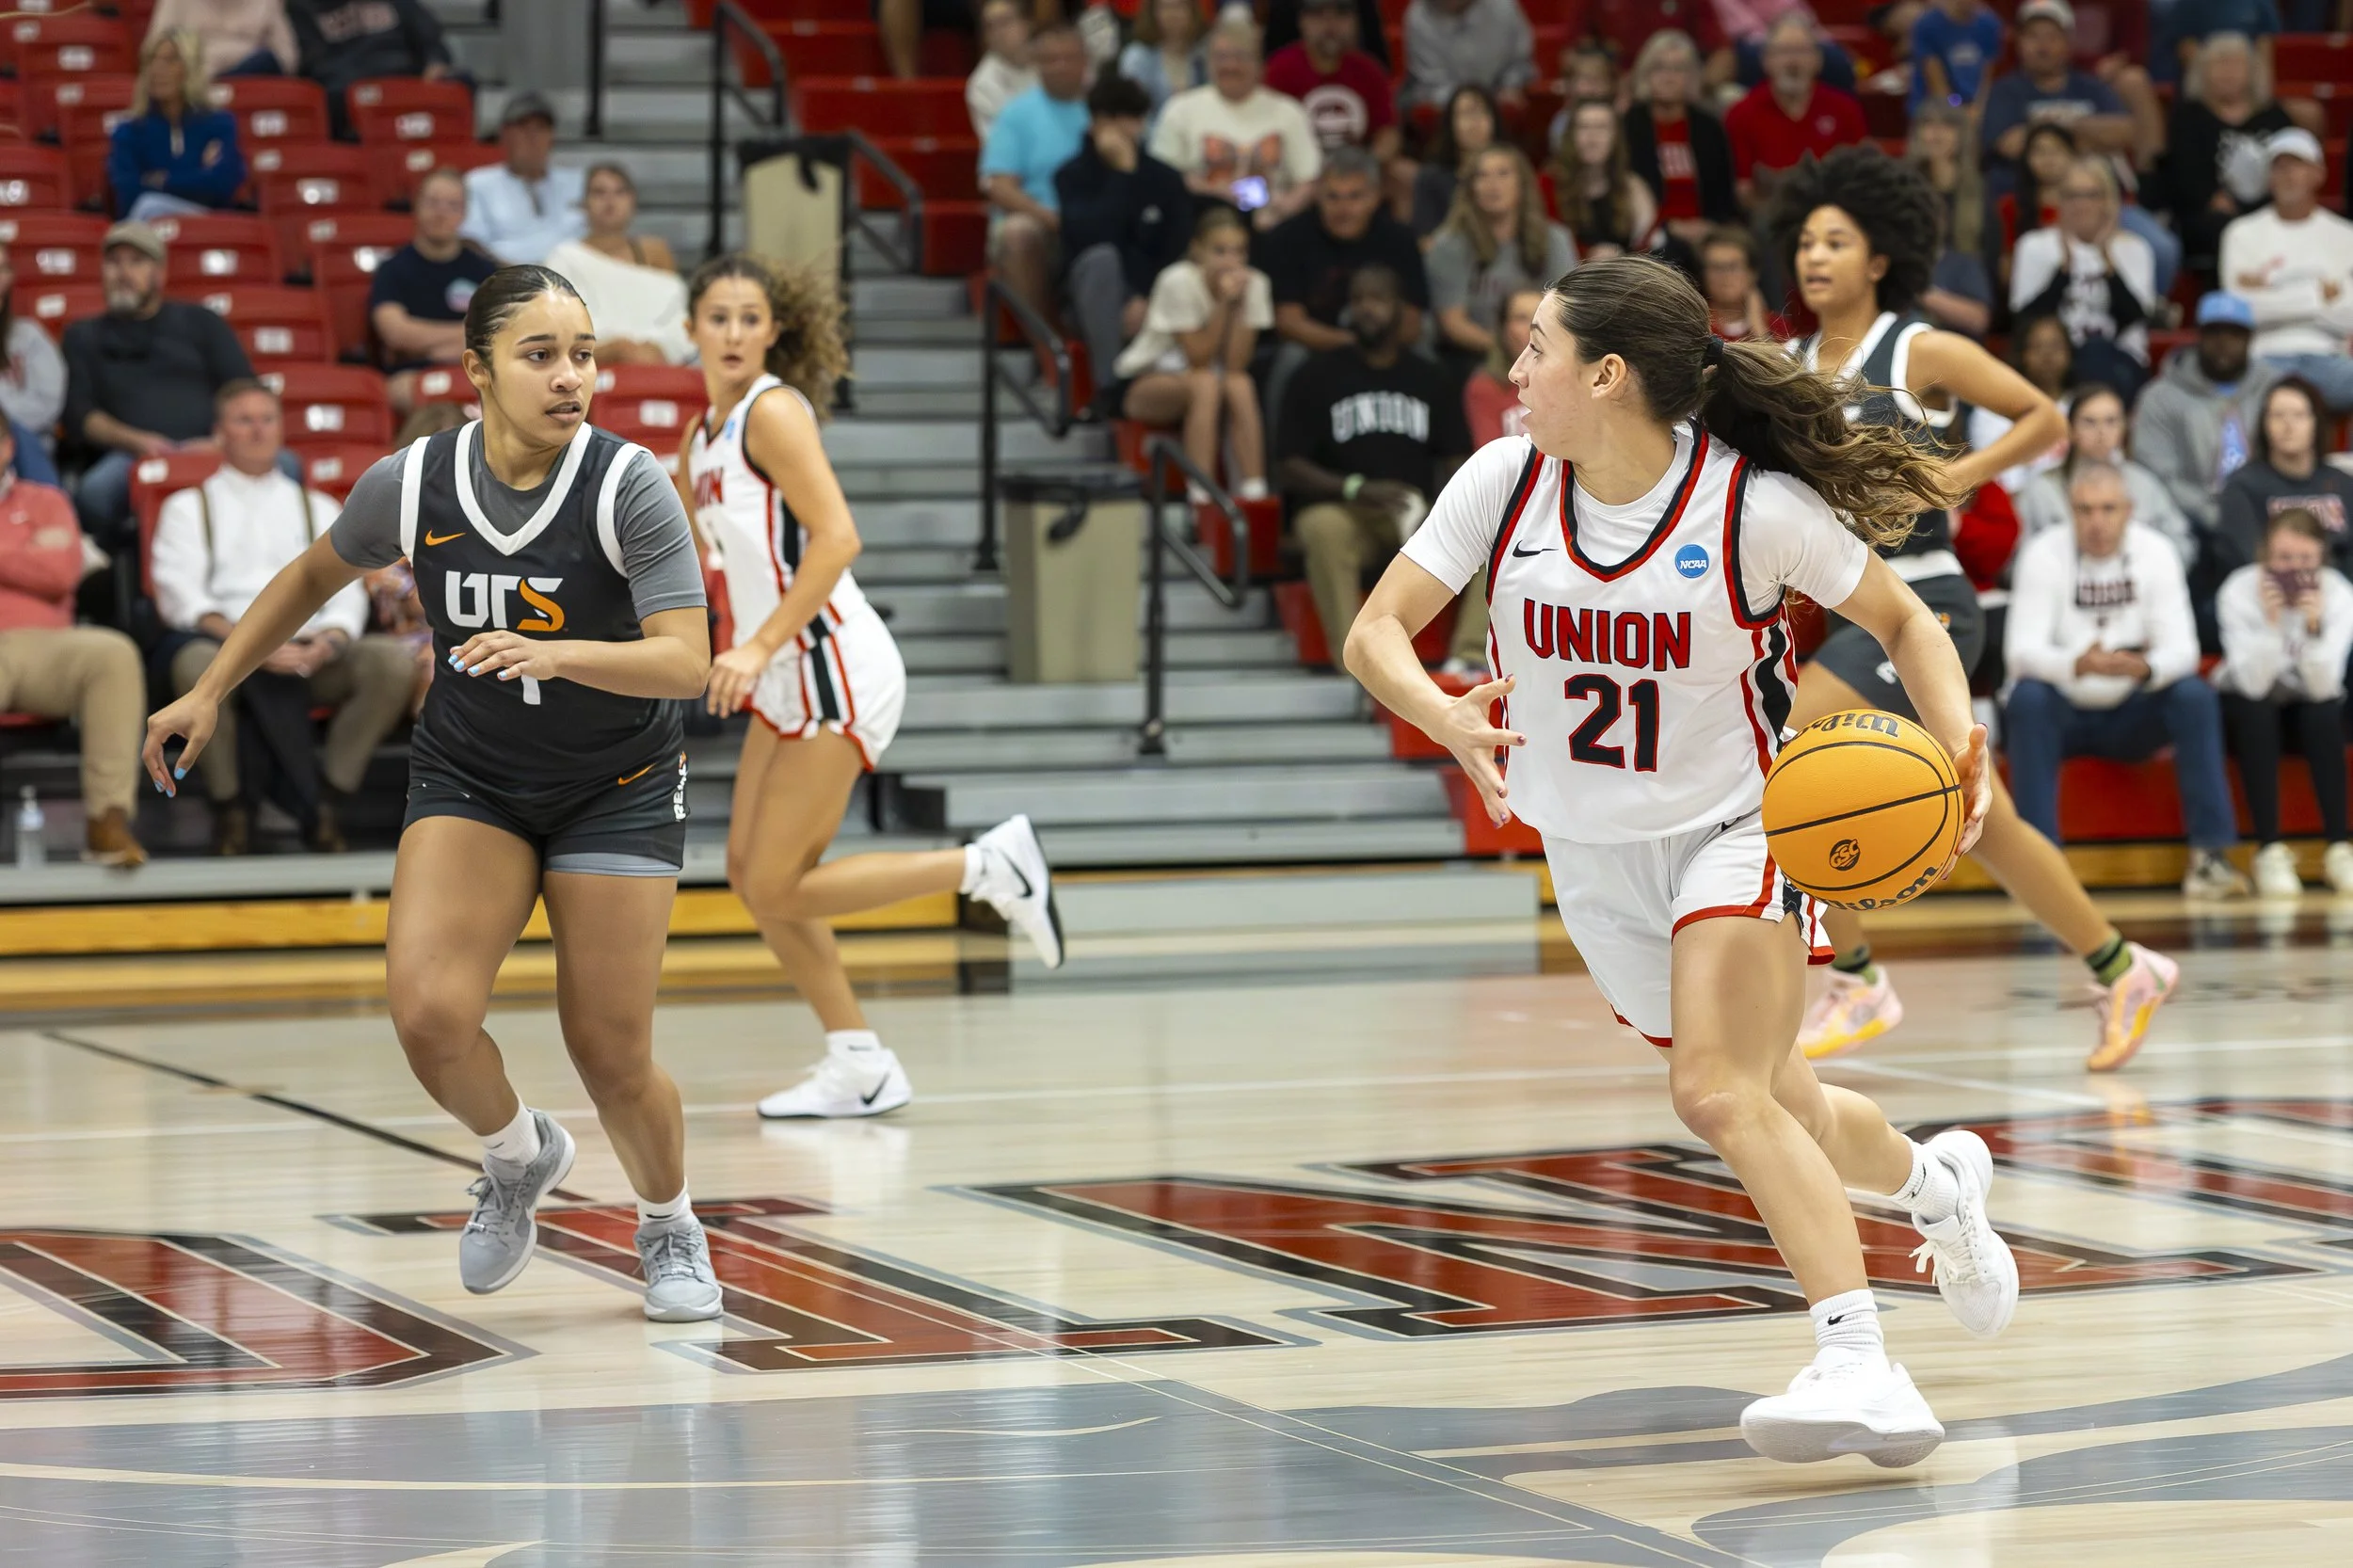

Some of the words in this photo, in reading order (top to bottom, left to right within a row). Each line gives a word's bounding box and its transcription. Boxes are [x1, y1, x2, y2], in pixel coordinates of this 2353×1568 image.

[1330, 391, 1430, 444] UNION
[1680, 559, 1707, 569] NCAA
[1524, 597, 1691, 672] UNION
[1564, 673, 1660, 772] 21
